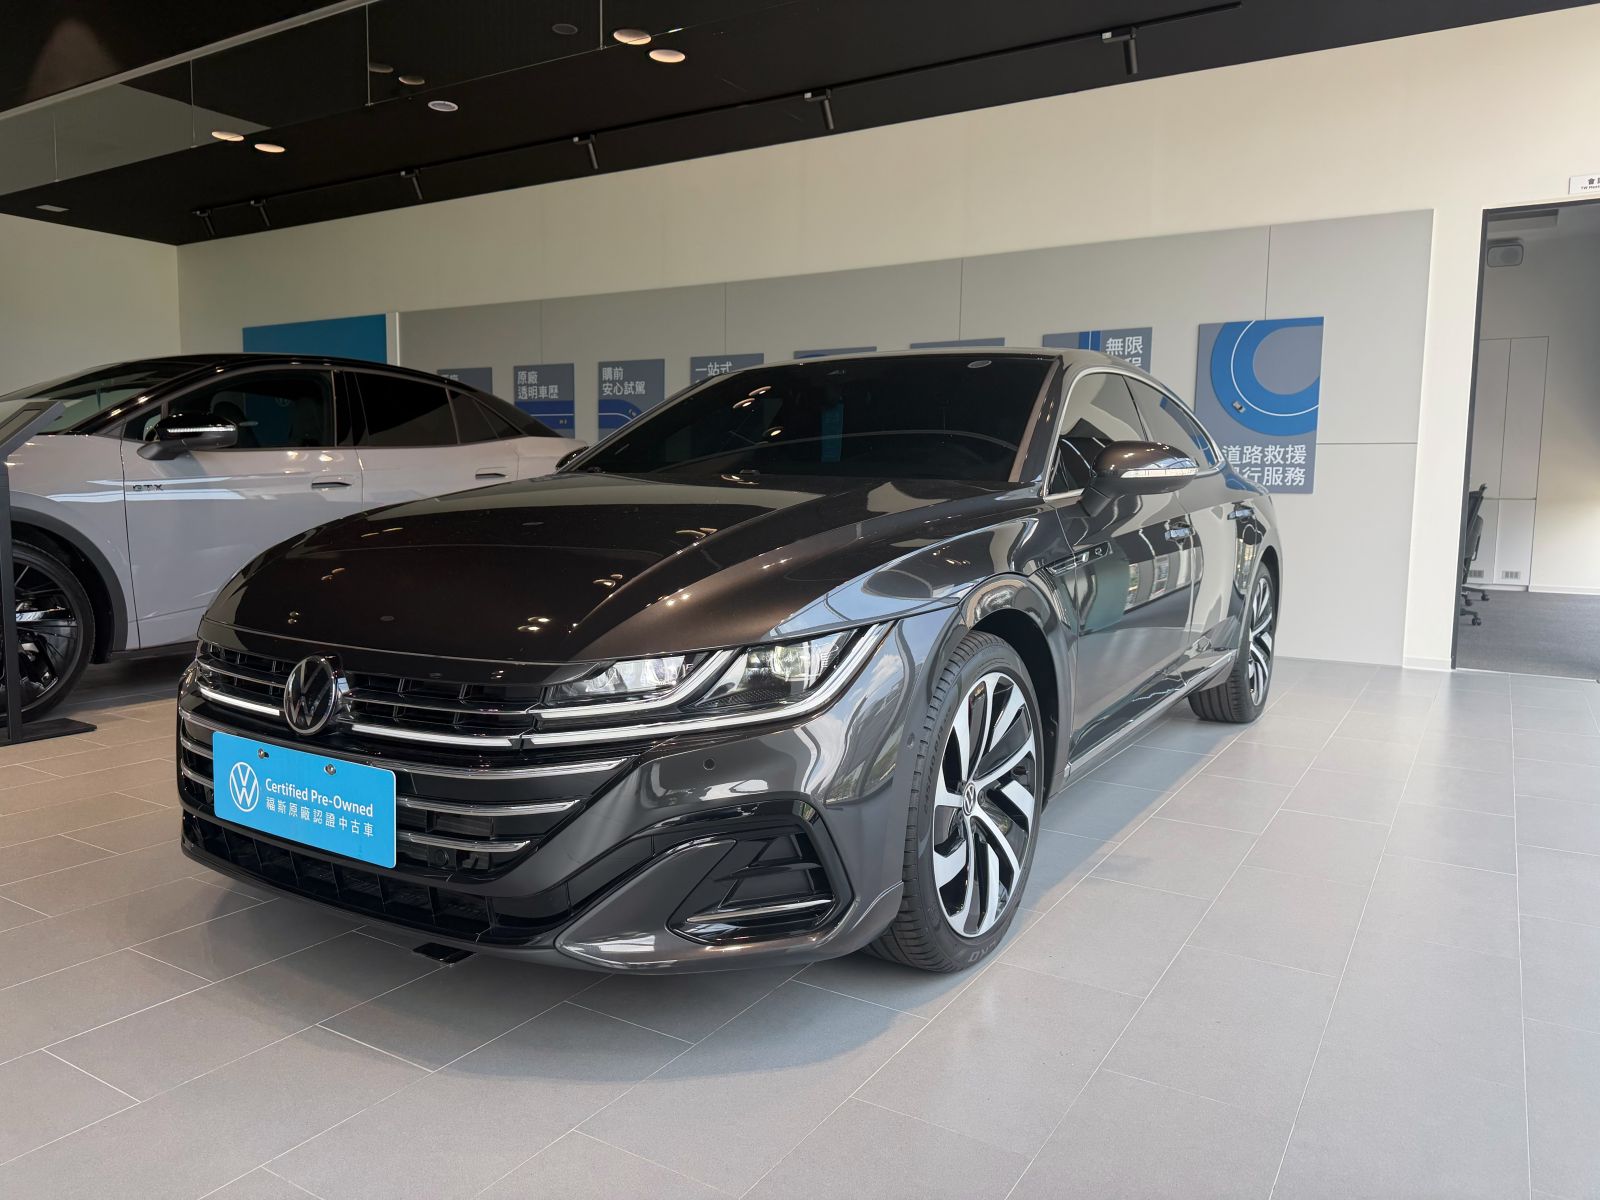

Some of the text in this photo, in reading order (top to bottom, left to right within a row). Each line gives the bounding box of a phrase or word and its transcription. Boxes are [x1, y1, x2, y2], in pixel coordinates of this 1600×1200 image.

[1106, 336, 1143, 355] 無限
[602, 367, 624, 381] 購前
[695, 361, 732, 376] 一站式
[517, 371, 538, 385] 原廠
[517, 385, 559, 400] 透明車歷
[602, 381, 646, 395] 安心試駕
[1222, 444, 1307, 465] 道路救援
[1232, 466, 1306, 486] 行服務
[265, 778, 374, 817] Certified Pre-Owned
[265, 796, 374, 838] 福斯原廠認證中古車
